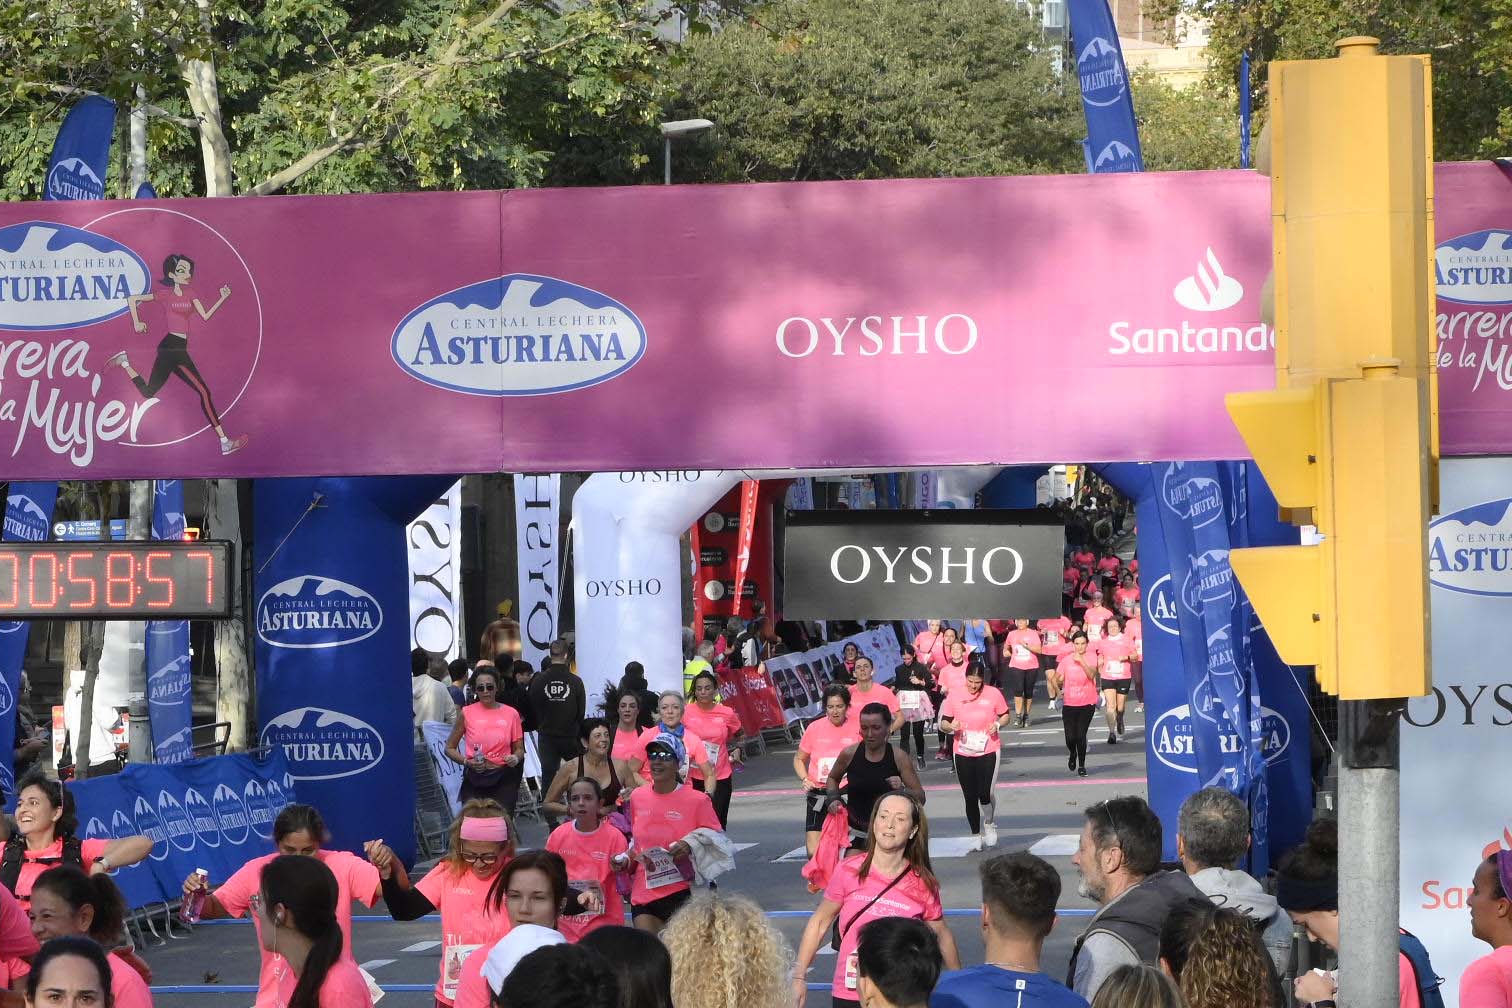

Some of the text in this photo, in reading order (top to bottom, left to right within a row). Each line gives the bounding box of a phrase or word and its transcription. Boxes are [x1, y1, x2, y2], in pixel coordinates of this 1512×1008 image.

[54, 257, 126, 269] LECHERA
[450, 314, 618, 329] CENTRAL LECHERA
[410, 321, 626, 366] ASTURIANA
[775, 314, 978, 357] OYSHO
[1458, 340, 1476, 368] la
[12, 372, 161, 467] Mujer
[830, 545, 1024, 586] OYSHO
[585, 578, 662, 598] OYSHO
[320, 600, 369, 608] LECHERA
[261, 604, 374, 632] ASTURIANA
[551, 685, 564, 695] BP
[265, 736, 375, 761] ATURIANA
